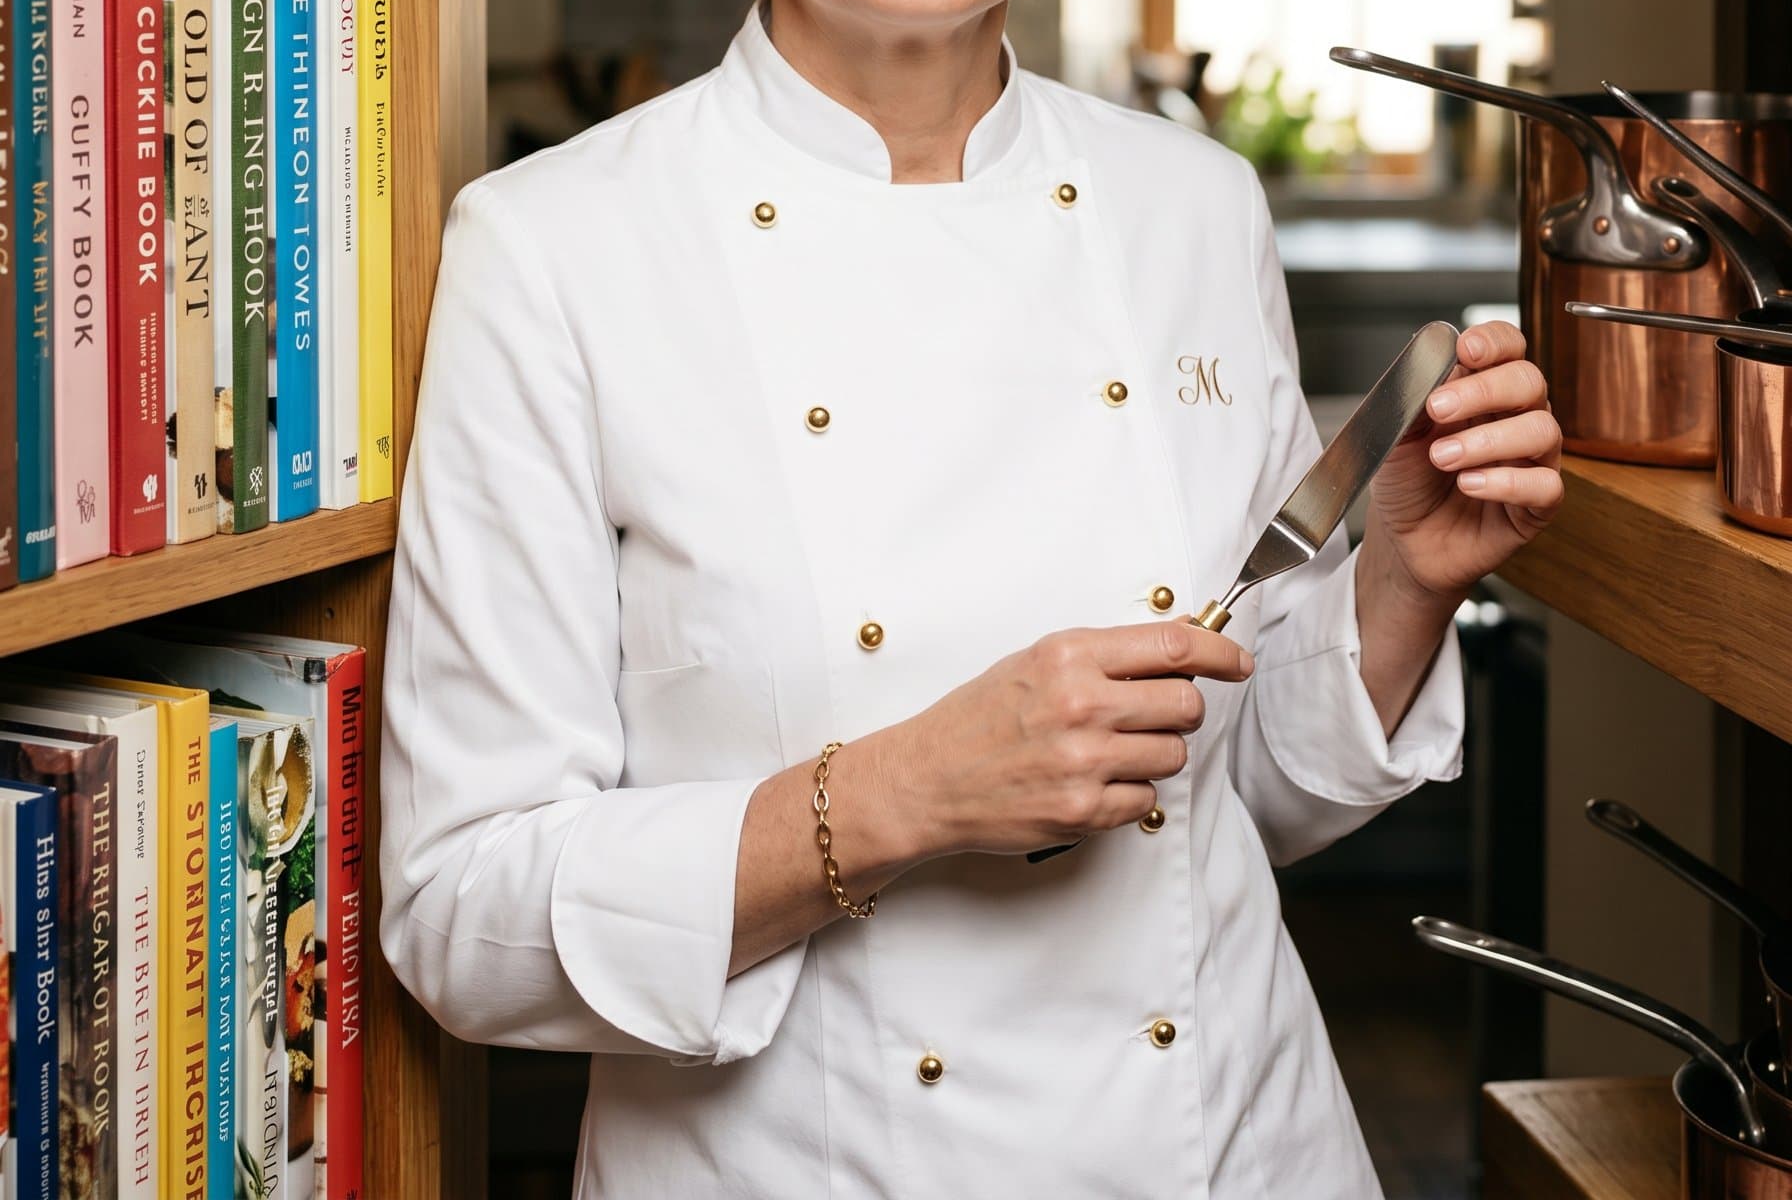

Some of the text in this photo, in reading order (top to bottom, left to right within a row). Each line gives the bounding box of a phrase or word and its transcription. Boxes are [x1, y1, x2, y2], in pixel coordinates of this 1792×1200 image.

[183, 9, 209, 104] OLD
[71, 95, 92, 218] GUFFY
[184, 118, 209, 175] OF
[137, 176, 158, 287] BOOK
[243, 205, 265, 328] HOOK
[72, 236, 94, 349] BOOK
[293, 223, 311, 352] TOWES
[1178, 356, 1232, 406] M
[187, 735, 201, 786] THE
[92, 782, 110, 857] THE
[134, 886, 149, 952] THE
[36, 967, 55, 1045] Book
